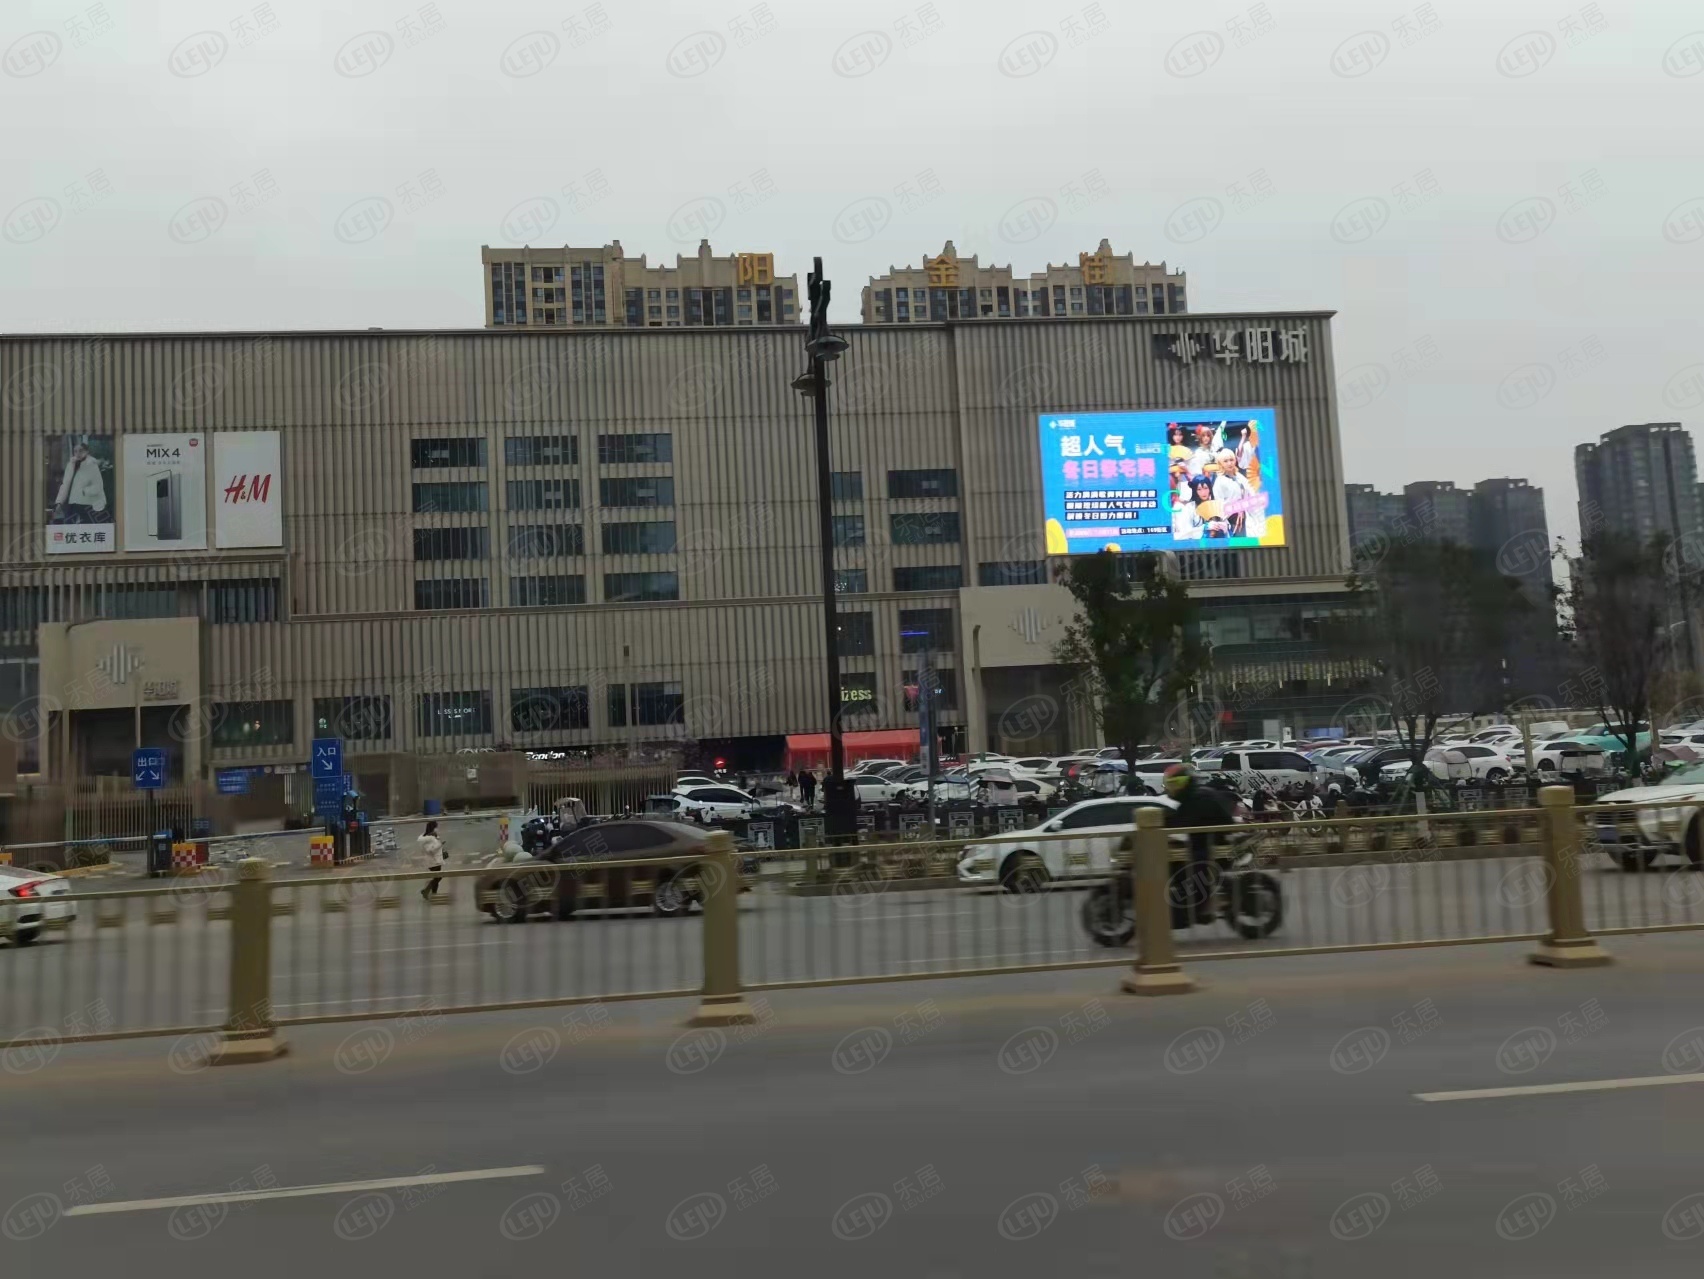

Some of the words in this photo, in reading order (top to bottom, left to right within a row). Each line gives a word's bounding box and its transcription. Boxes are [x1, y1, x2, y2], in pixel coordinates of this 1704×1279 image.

[737, 253, 774, 285] 阳
[923, 254, 960, 287] 金
[1212, 325, 1309, 366] 华阳城
[146, 448, 170, 458] MIX
[171, 448, 181, 458] 4
[1061, 434, 1126, 457] 超人气
[224, 473, 271, 505] H&M
[65, 531, 107, 544] 优衣库
[317, 747, 336, 757] 入口
[137, 756, 158, 768] 出口
